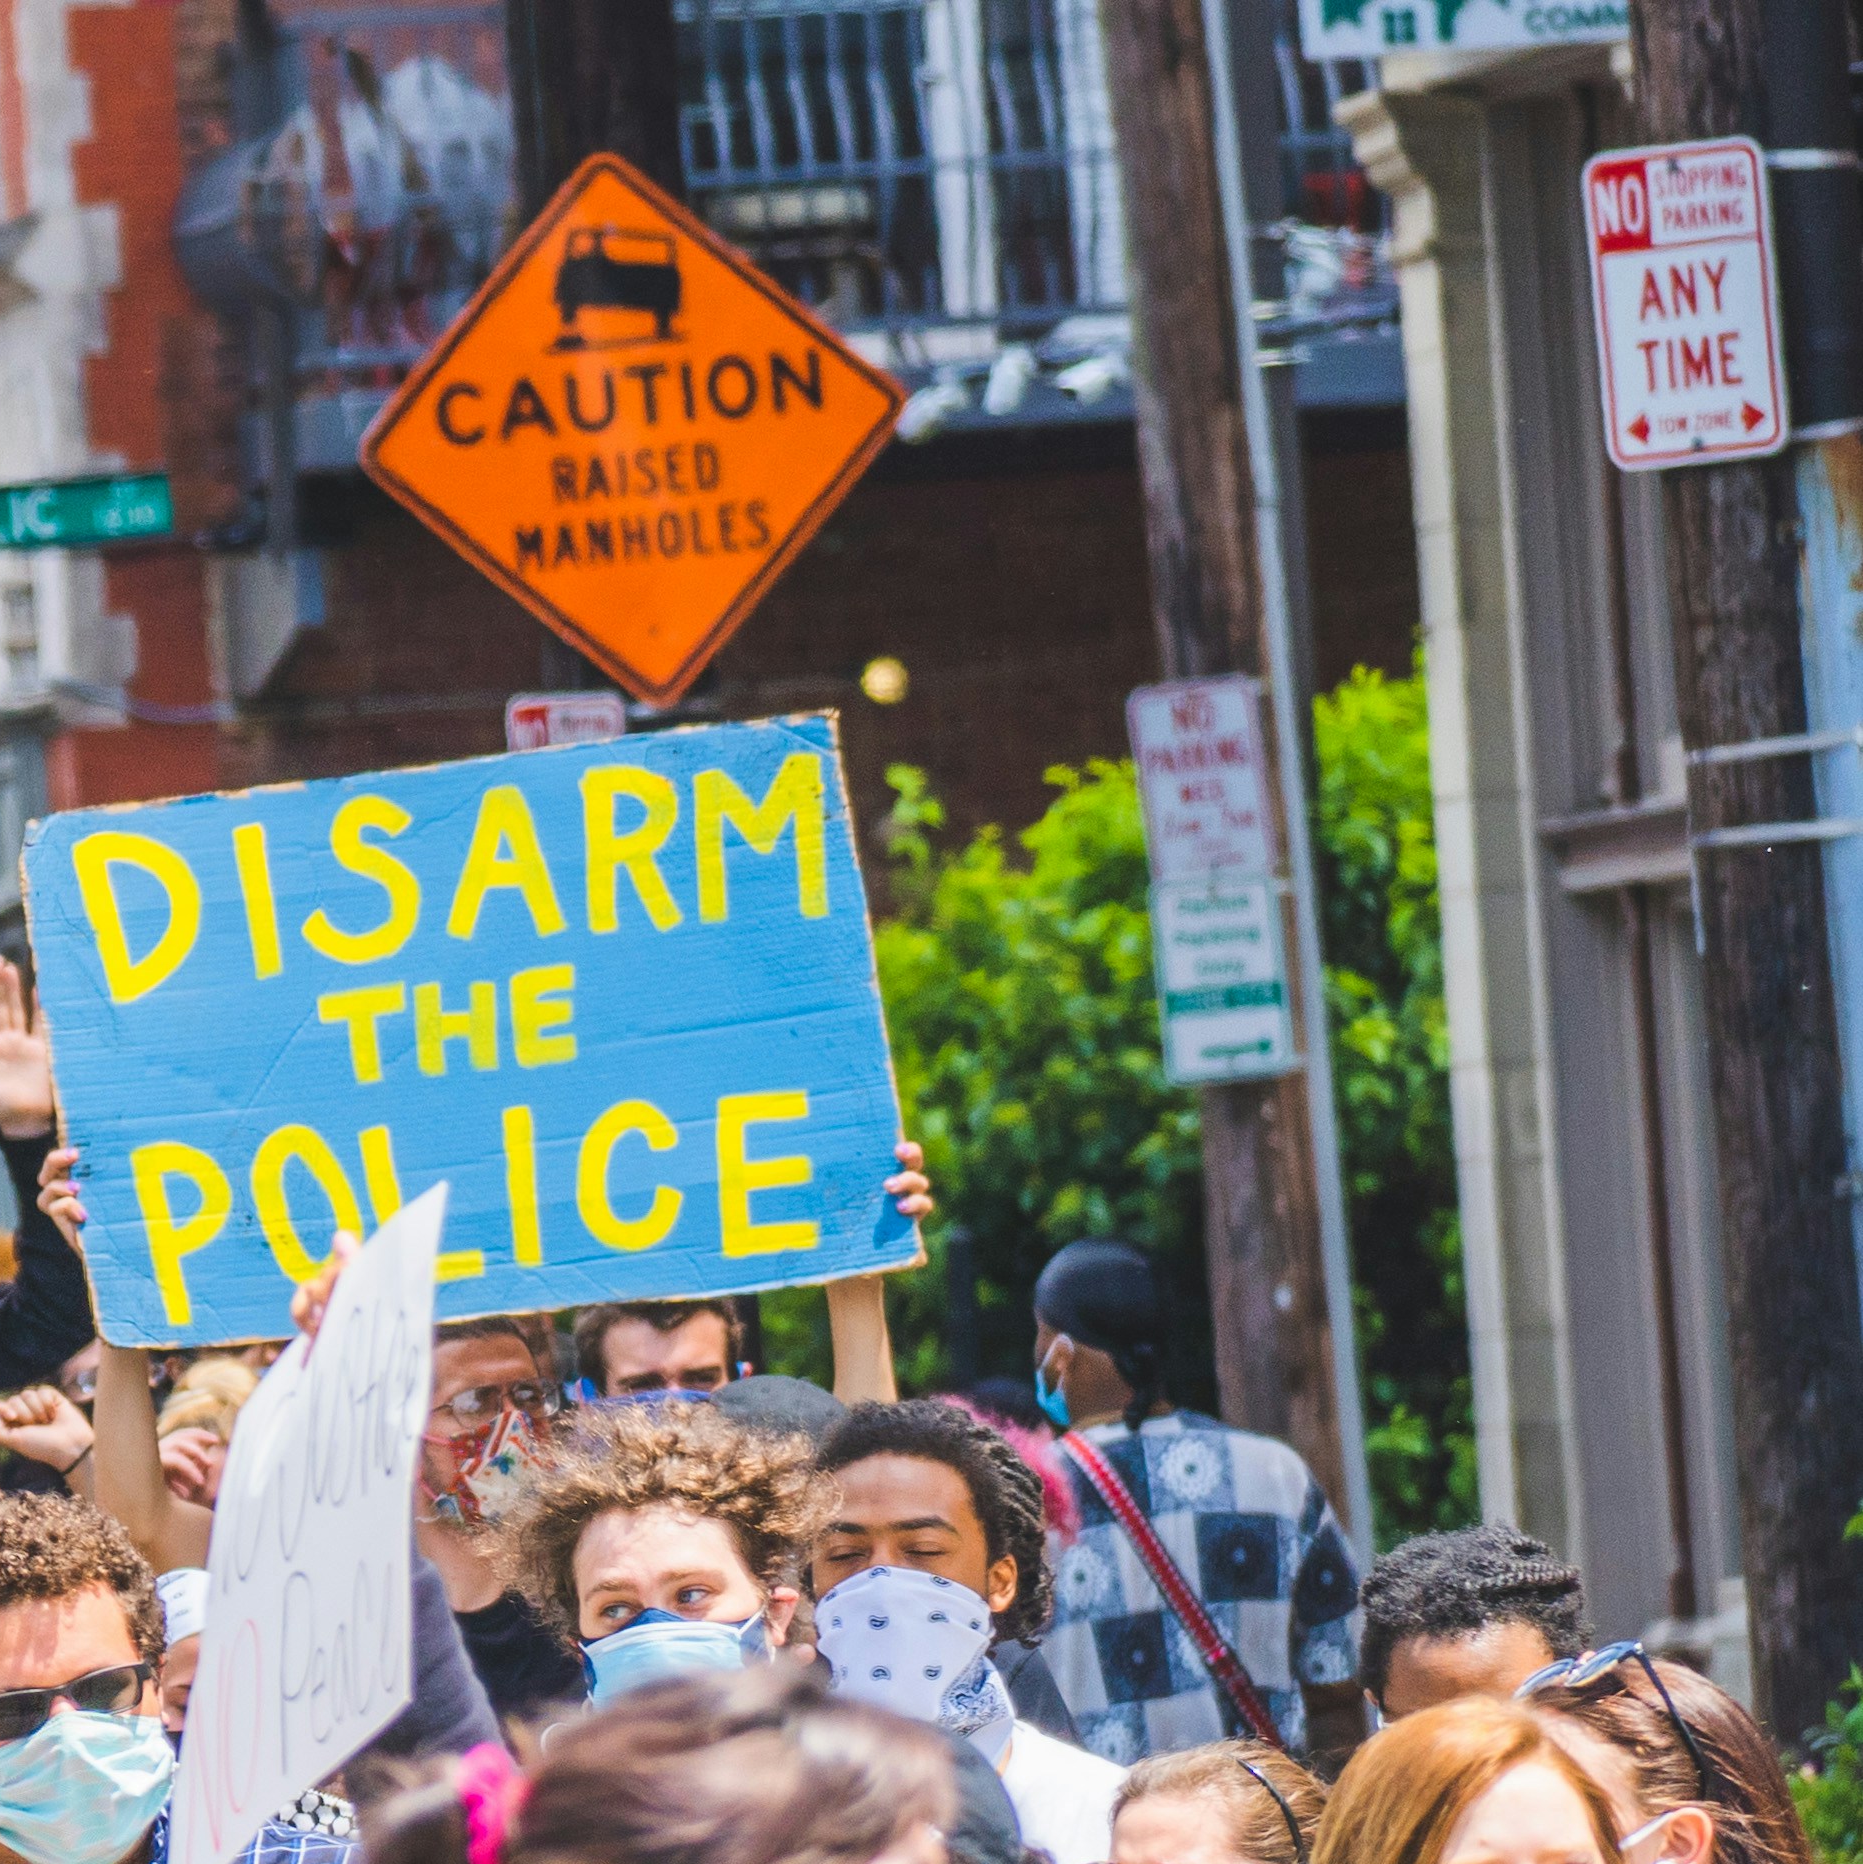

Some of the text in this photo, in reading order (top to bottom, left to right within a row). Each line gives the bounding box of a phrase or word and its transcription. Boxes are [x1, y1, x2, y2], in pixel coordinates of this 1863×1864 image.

[1593, 160, 1746, 236] NO STOPPING
[1663, 202, 1744, 231] PARKING
[1639, 258, 1726, 322] ANY
[434, 350, 826, 446] CAUTION
[1637, 331, 1743, 393] TIME
[550, 442, 721, 506] RAISED
[512, 501, 772, 575] MANHOLES
[73, 752, 828, 1003] DISARM
[318, 963, 577, 1084] THE
[131, 1088, 823, 1326] POLICE
